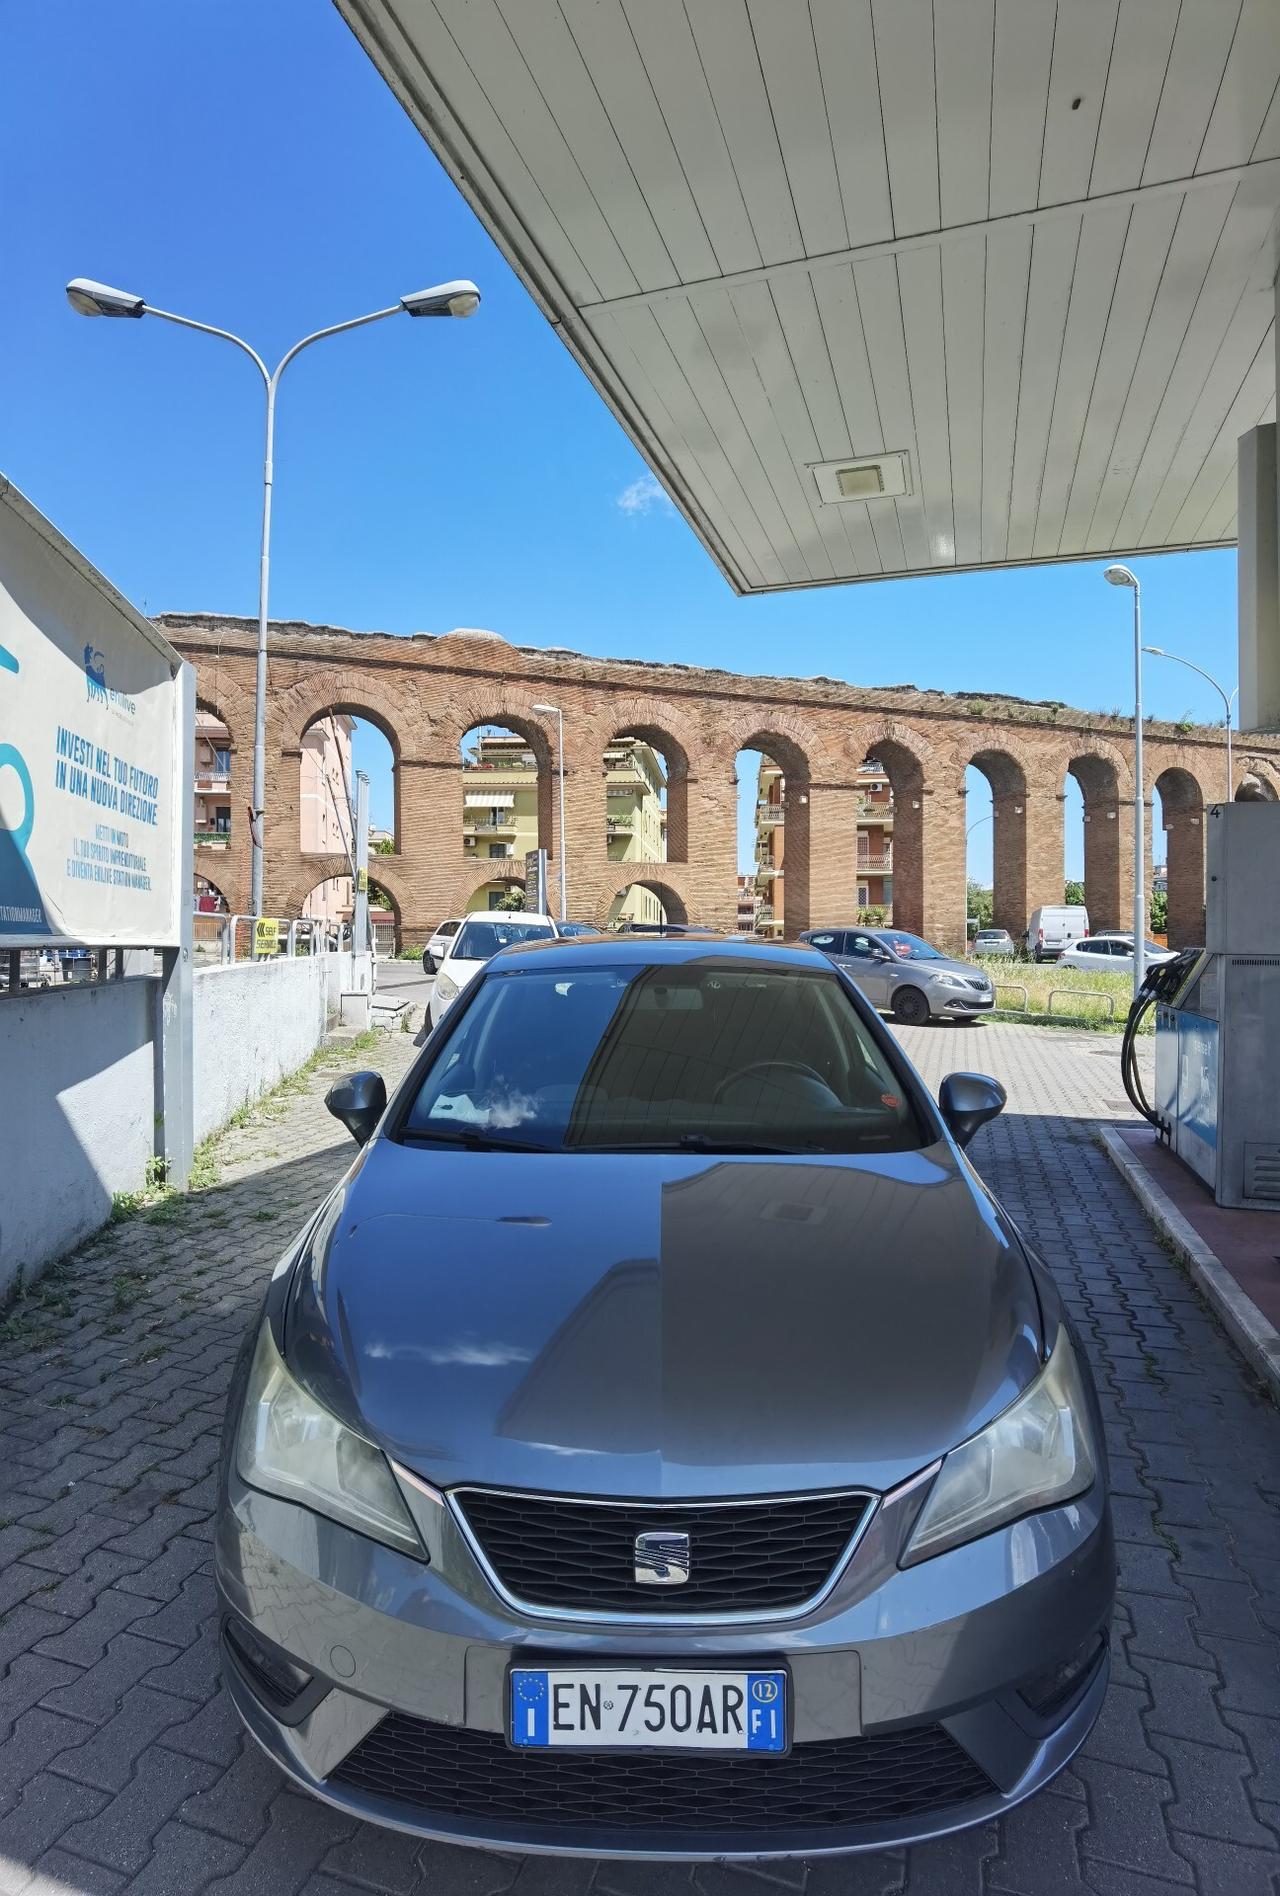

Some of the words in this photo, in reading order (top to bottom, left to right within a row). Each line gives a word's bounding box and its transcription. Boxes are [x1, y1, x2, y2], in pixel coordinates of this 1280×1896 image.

[55, 759, 67, 790] IN
[69, 765, 88, 799] UNA
[90, 775, 118, 811] NUOVA
[56, 725, 94, 770] INVESTI
[96, 747, 111, 778] NEL
[114, 756, 128, 786] TUO
[129, 765, 159, 799] FUTURO
[1210, 804, 1221, 819] 4
[553, 1682, 602, 1732] EN
[616, 1683, 745, 1735] 750AR
[757, 1683, 773, 1698] 12
